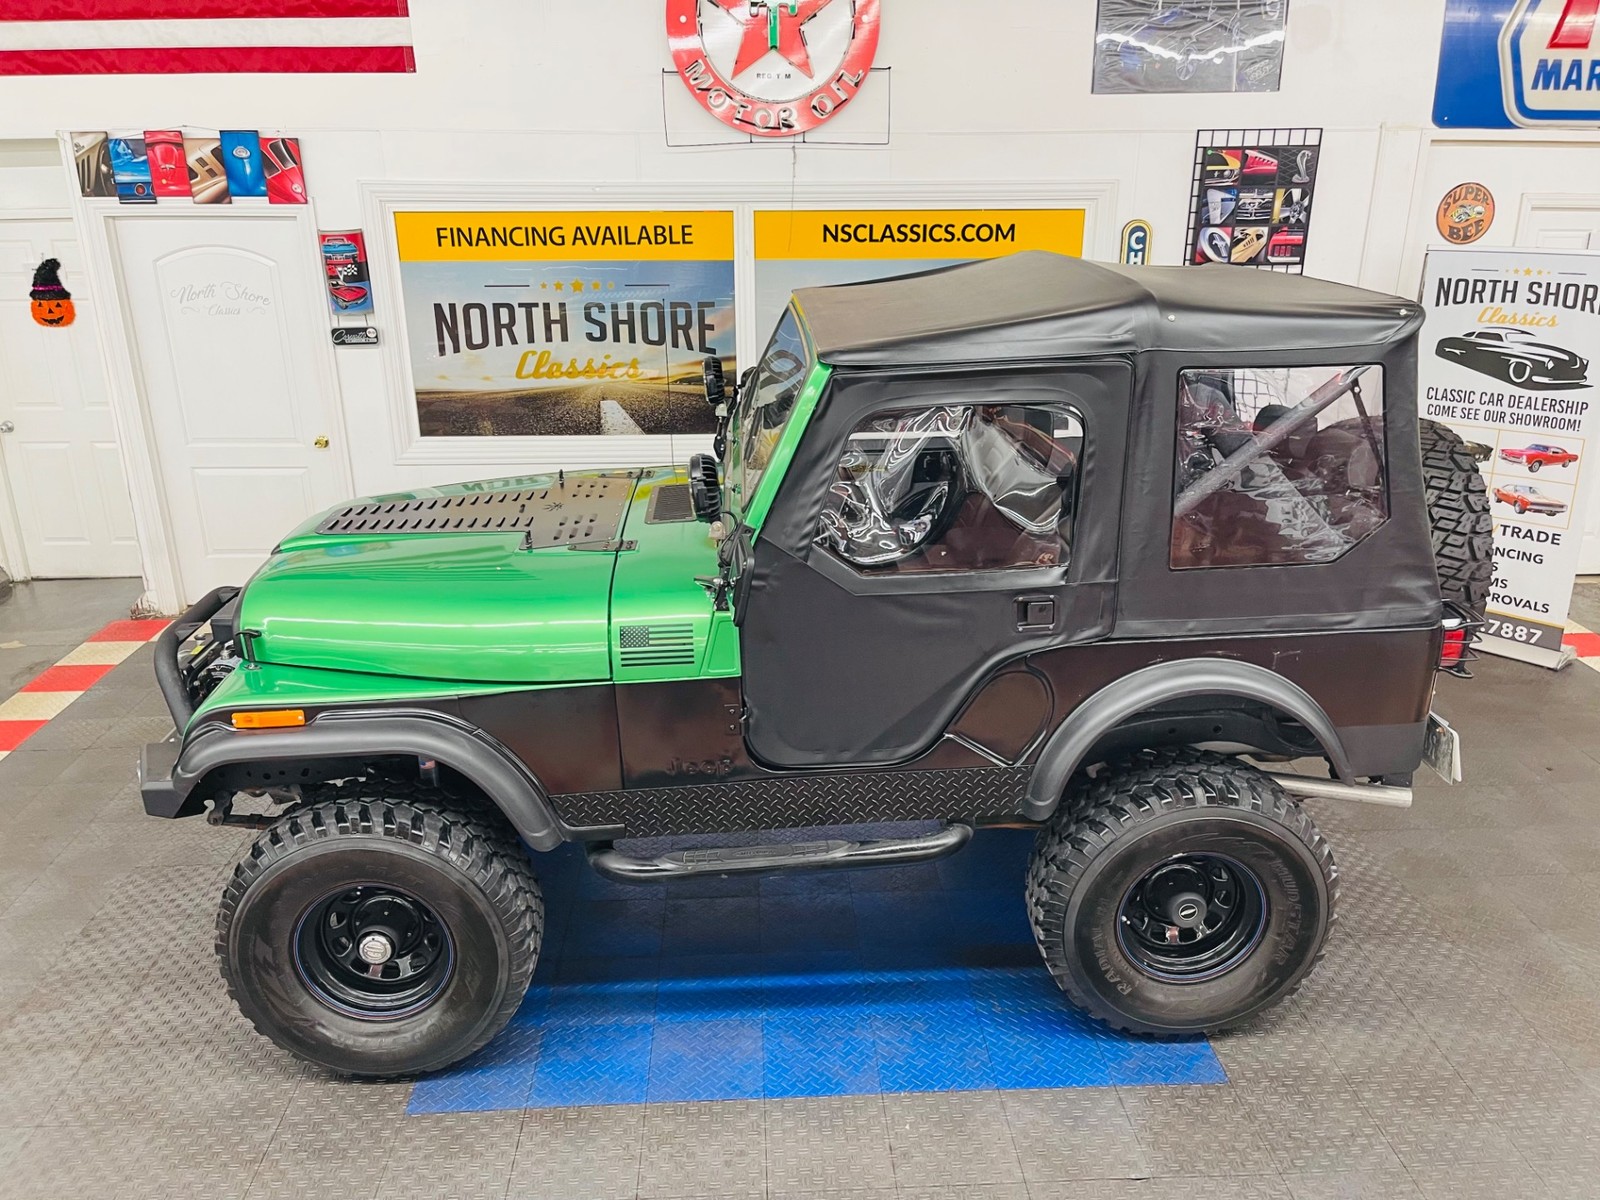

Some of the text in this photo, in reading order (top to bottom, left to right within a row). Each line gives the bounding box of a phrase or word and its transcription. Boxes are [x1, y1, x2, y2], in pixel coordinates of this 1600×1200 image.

[1531, 59, 1600, 91] MAR
[685, 60, 864, 132] MOTOR OIL
[1443, 186, 1489, 218] SUPER
[436, 225, 694, 248] FINANCING AVAILABLE
[822, 223, 1016, 243] NSCLASSICS.COM
[1447, 219, 1484, 241] BEE
[1129, 231, 1145, 264] CH
[170, 281, 271, 306] North Shore
[1435, 278, 1600, 315] NORTH SHOR
[434, 301, 717, 357] NORTH SHORE
[1477, 306, 1559, 327] Classics
[515, 350, 643, 380] Classics
[1426, 386, 1589, 415] CLASSIC CAR DEALERSHIP
[1427, 404, 1581, 432] COME SEE OUR SHOWROOM!
[1500, 524, 1562, 545] TRADE
[1493, 546, 1544, 565] NCING
[1490, 592, 1550, 614] ROVALS
[1480, 619, 1543, 644] .7887
